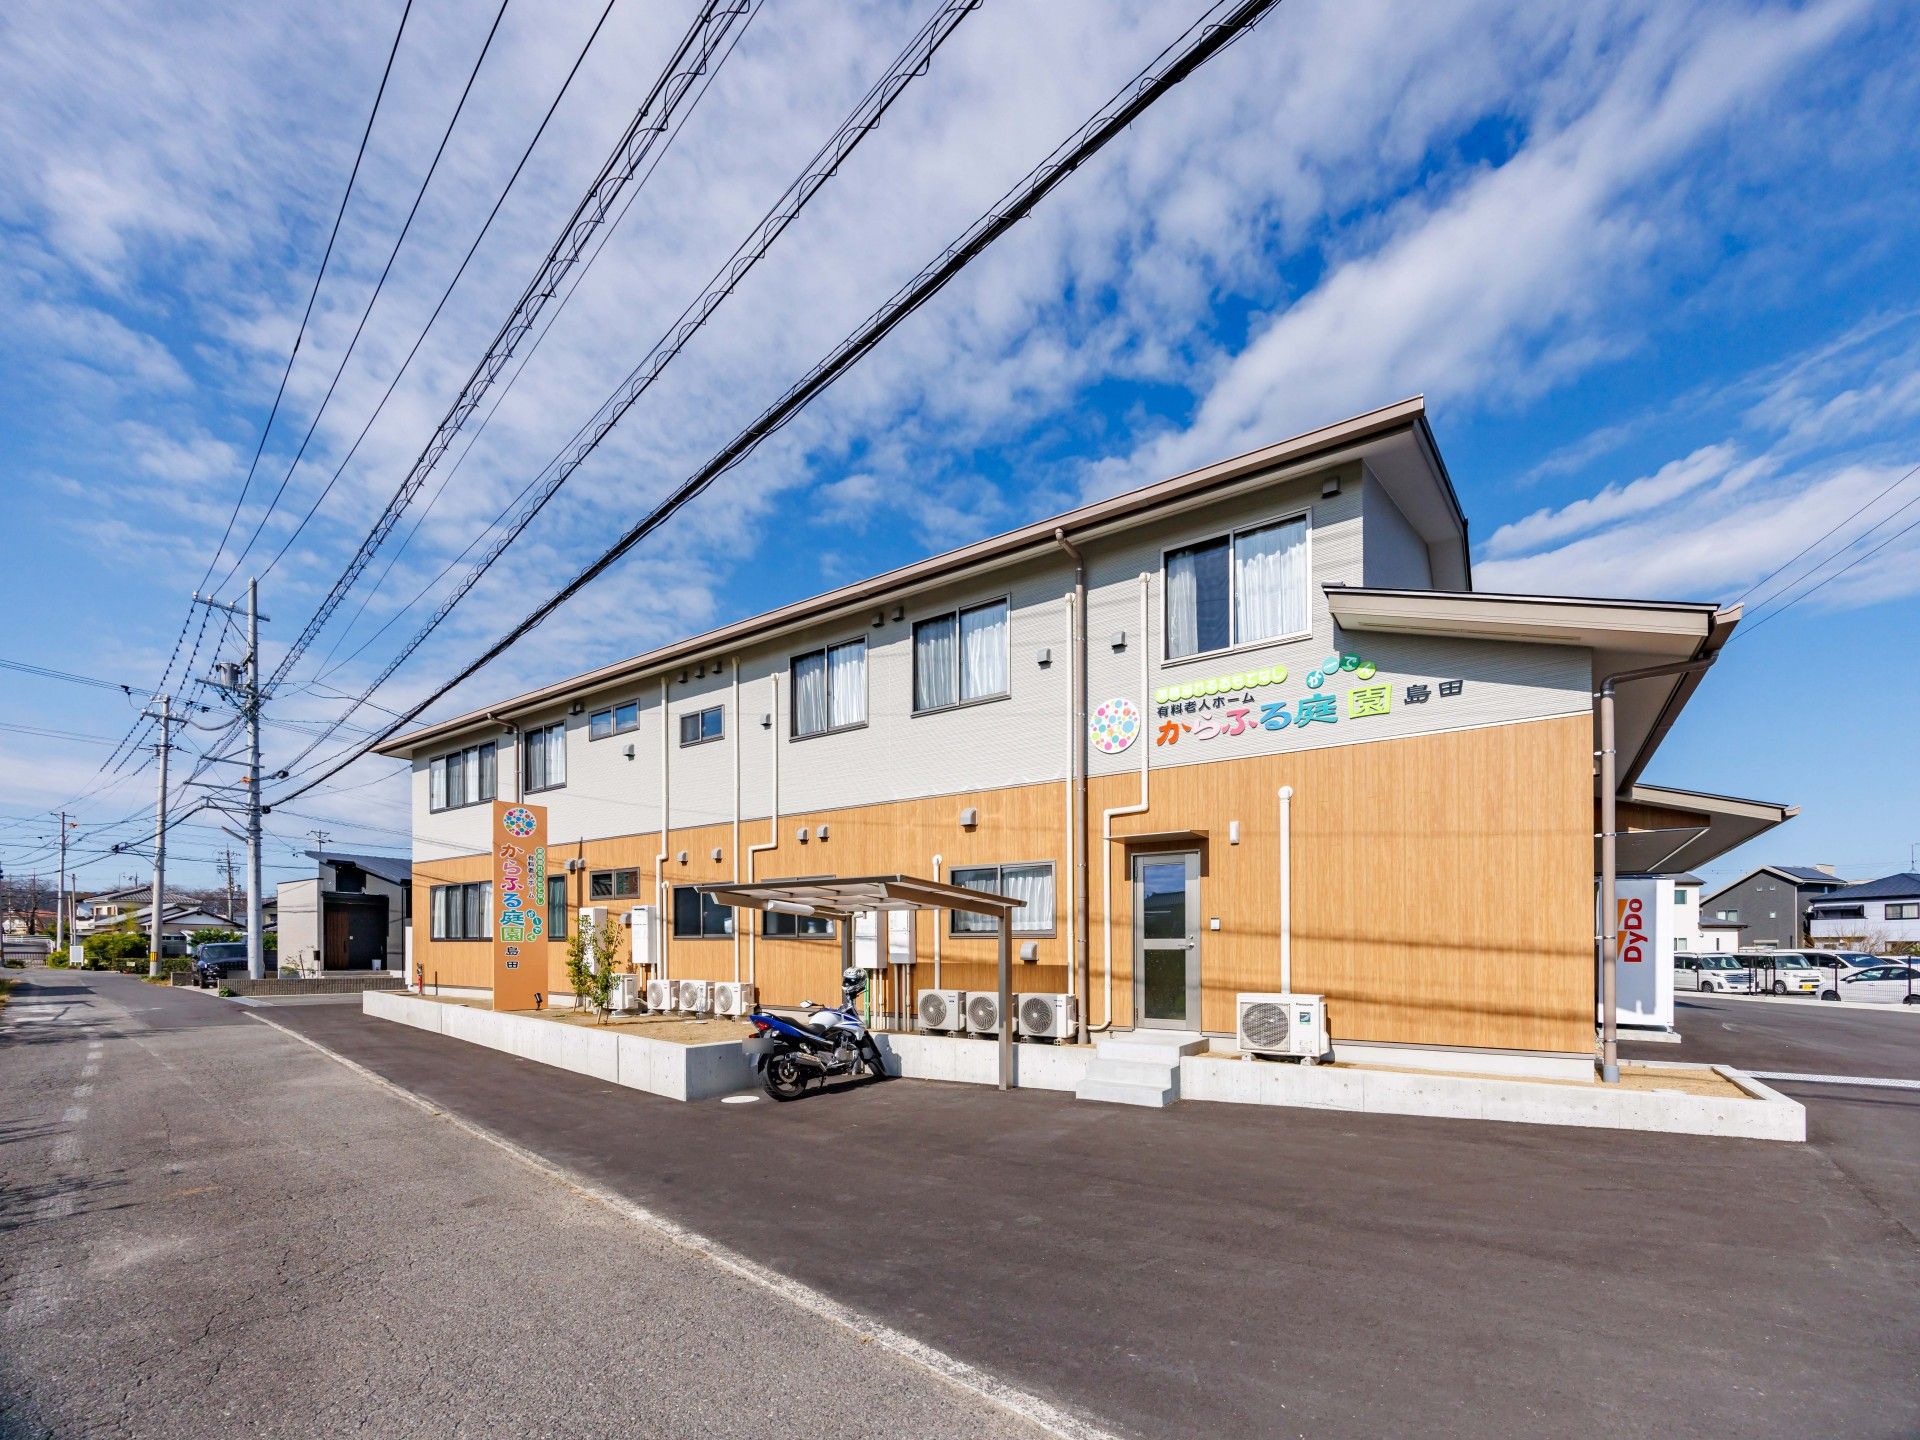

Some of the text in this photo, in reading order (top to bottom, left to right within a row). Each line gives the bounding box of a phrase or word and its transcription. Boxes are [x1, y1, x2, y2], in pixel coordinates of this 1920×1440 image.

[1305, 653, 1375, 688] がーでん
[1157, 692, 1255, 718] 有料老人ホーム
[1404, 679, 1463, 706] 島田
[1624, 898, 1648, 962] DyDo
[505, 946, 519, 968] 島田
